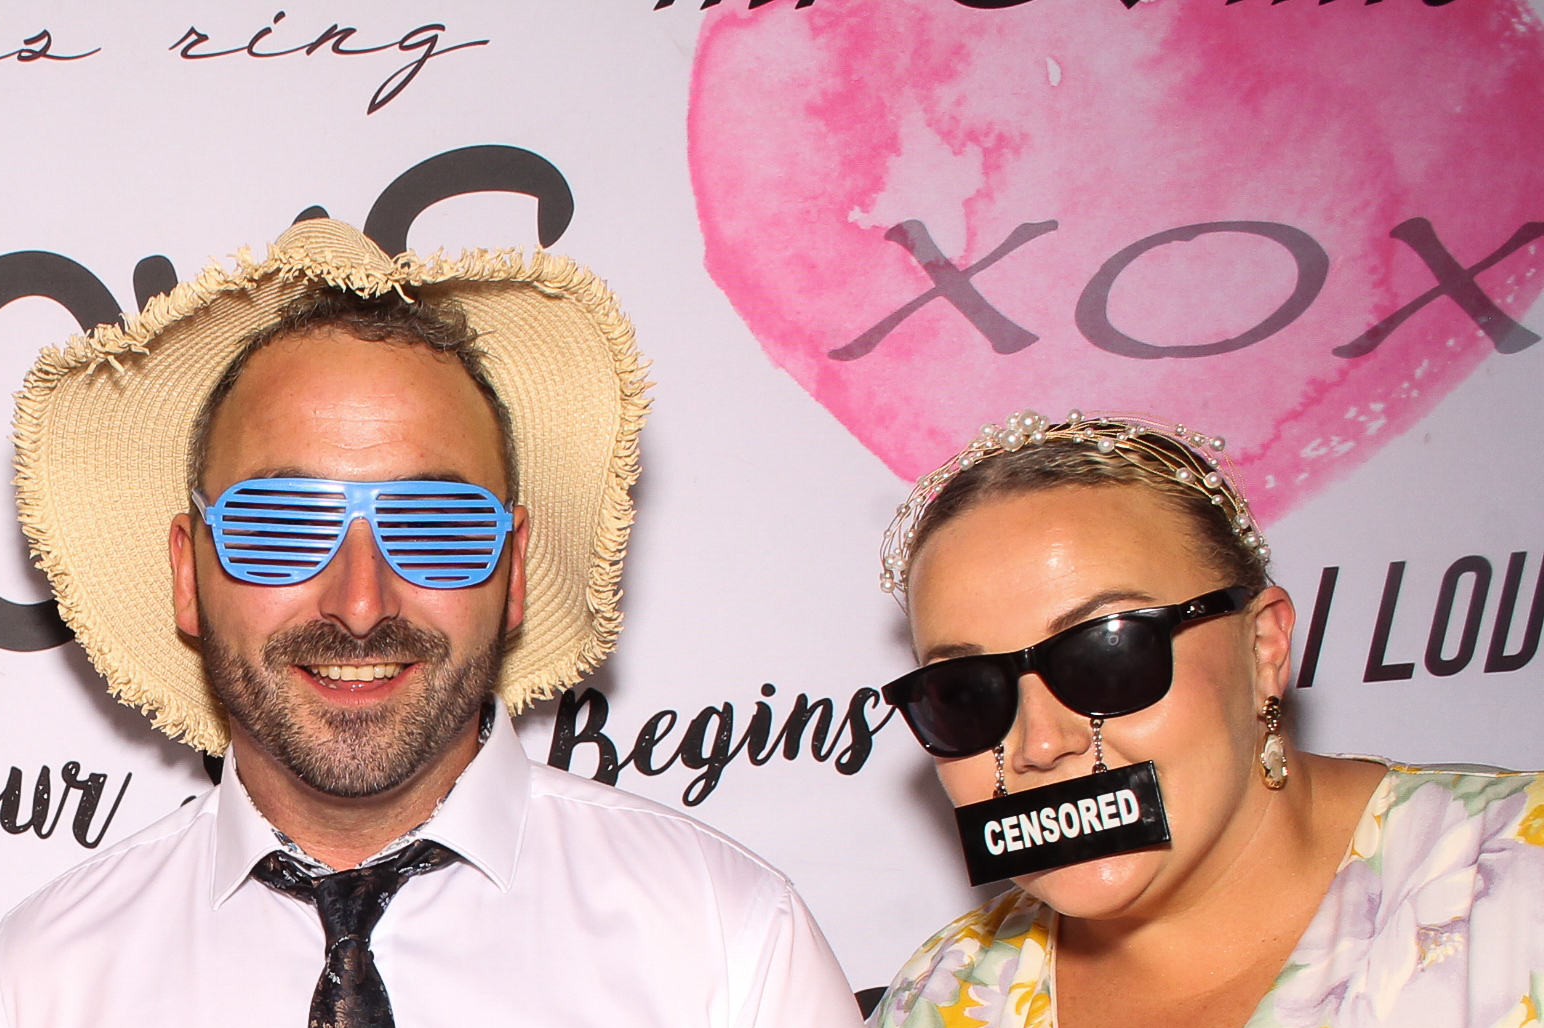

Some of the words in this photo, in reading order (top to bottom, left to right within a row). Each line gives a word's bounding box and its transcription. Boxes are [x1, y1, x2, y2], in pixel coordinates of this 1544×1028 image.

[169, 10, 490, 116] ring
[1296, 565, 1340, 689] I
[547, 683, 898, 807] Begins
[983, 788, 1141, 857] CENSORED
